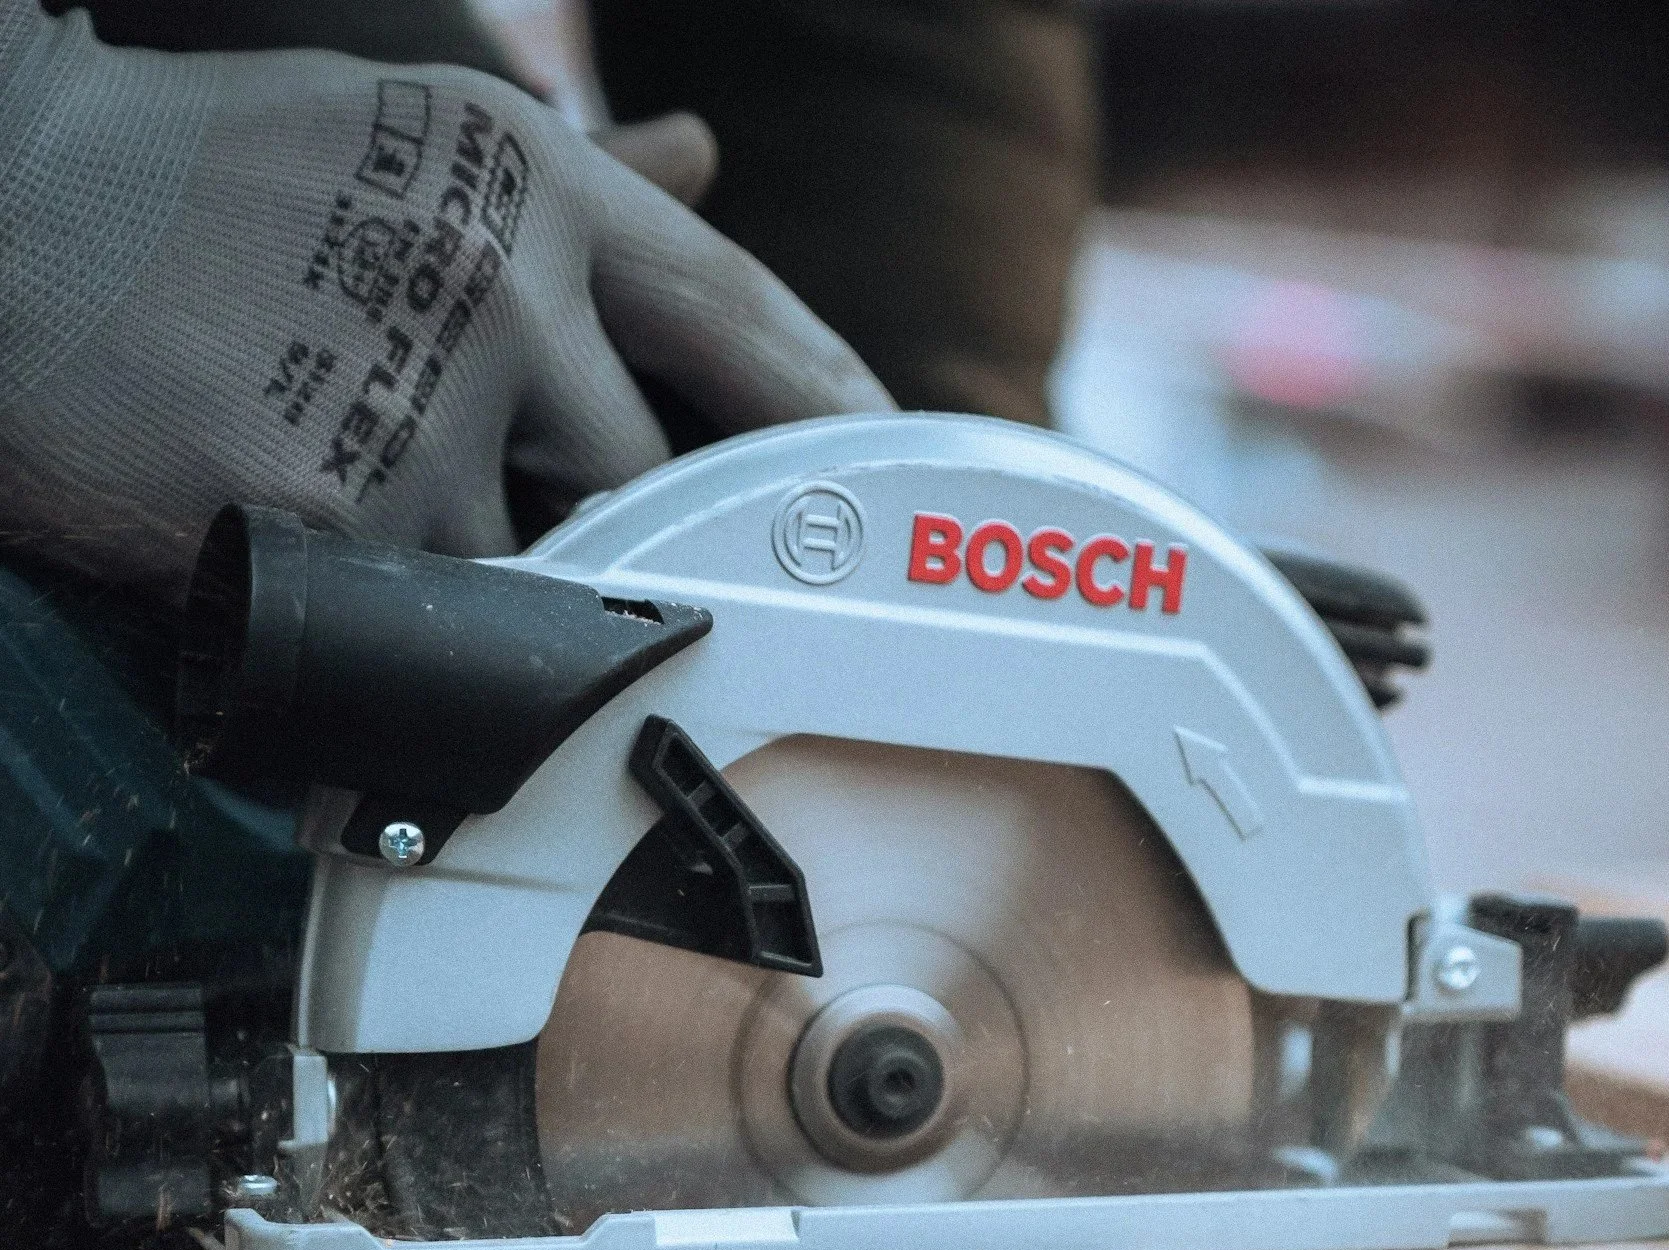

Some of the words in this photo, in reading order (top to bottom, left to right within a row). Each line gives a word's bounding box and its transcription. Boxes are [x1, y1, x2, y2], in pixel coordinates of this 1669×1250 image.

[407, 103, 493, 313] MICRO
[320, 326, 413, 483] FLEX
[907, 511, 1187, 614] BOSCH
